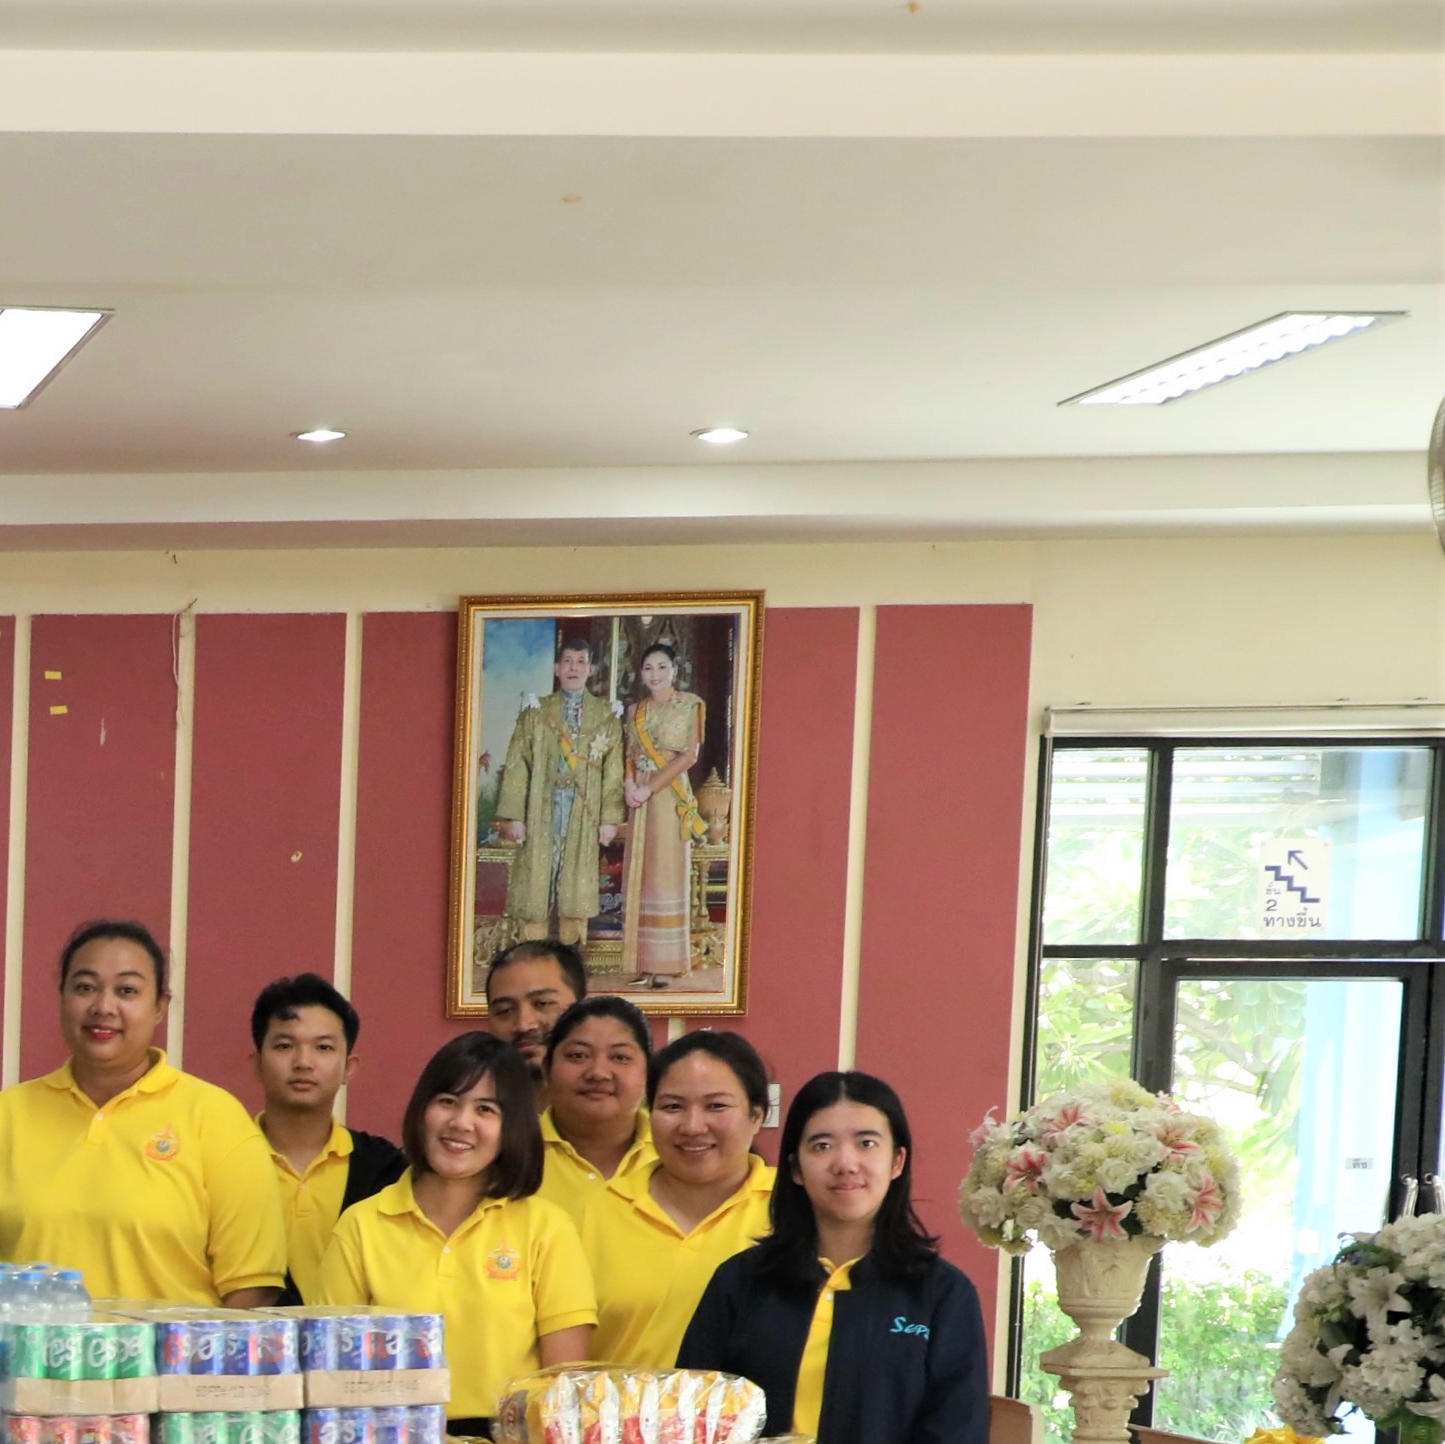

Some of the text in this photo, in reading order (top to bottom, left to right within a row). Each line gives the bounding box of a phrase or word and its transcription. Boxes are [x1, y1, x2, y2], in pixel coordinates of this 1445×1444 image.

[1266, 898, 1278, 912] 2
[1263, 907, 1322, 928] ทางขึ้น
